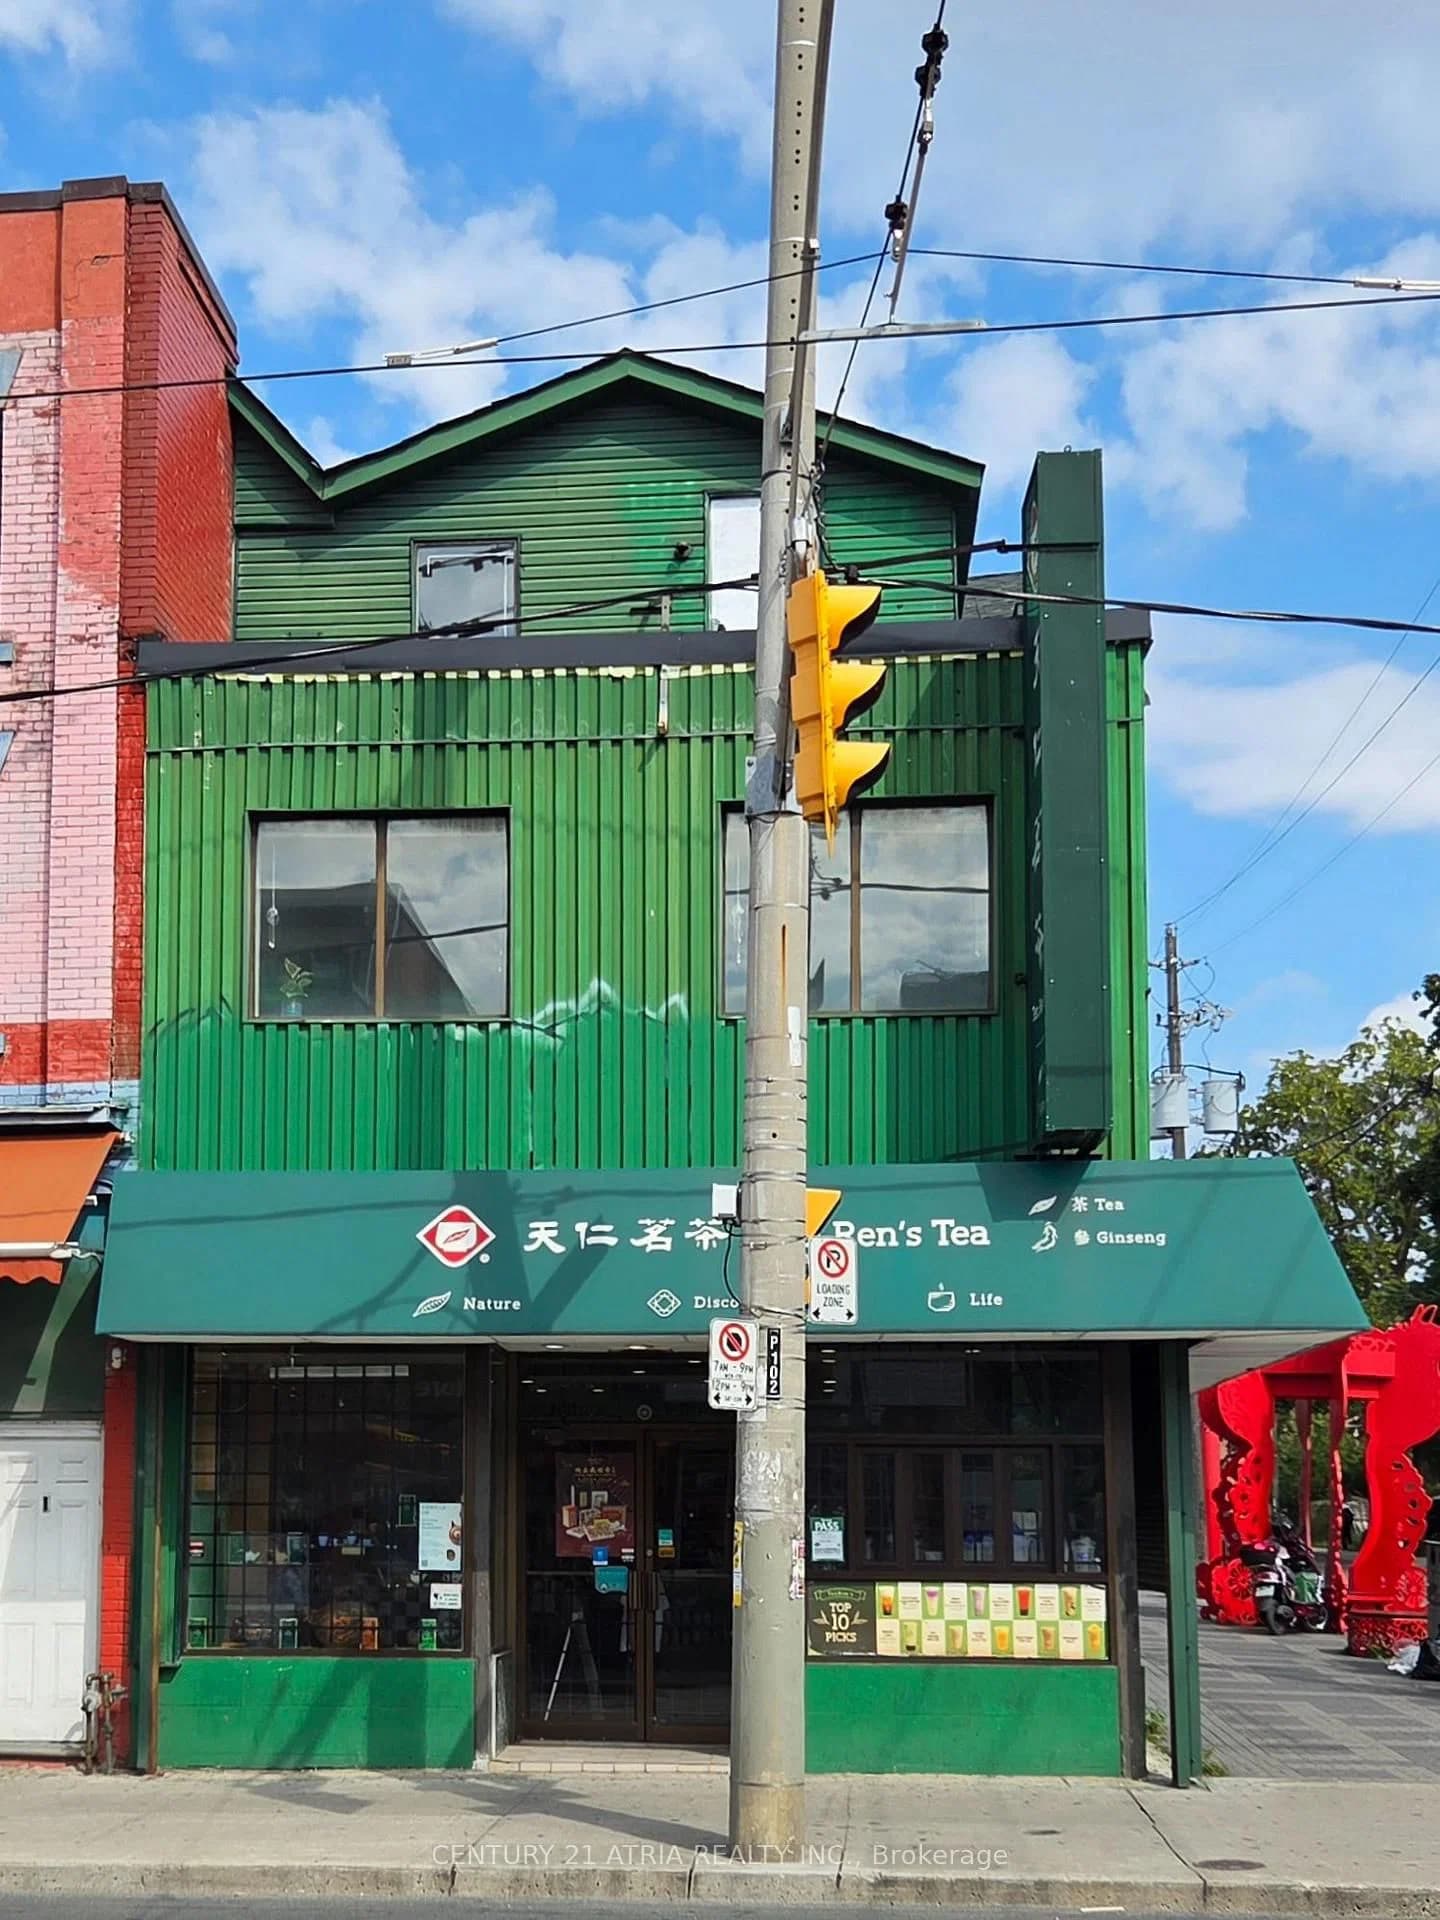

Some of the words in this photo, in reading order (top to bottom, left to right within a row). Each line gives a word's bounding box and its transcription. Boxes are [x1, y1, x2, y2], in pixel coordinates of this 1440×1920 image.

[1094, 1198, 1125, 1212] Tea
[523, 1217, 730, 1254] 天仁茗茶
[931, 1218, 991, 1247] Tea
[1096, 1231, 1167, 1247] Ginseng
[816, 1283, 851, 1296] LOADING
[463, 1296, 521, 1310] Nature
[694, 1296, 740, 1309] Disco
[823, 1296, 844, 1308] ZONE
[970, 1292, 1003, 1306] Life
[814, 1520, 839, 1532] PASS
[829, 1602, 852, 1613] TOP
[831, 1613, 850, 1631] 10
[825, 1631, 857, 1643] PICKS
